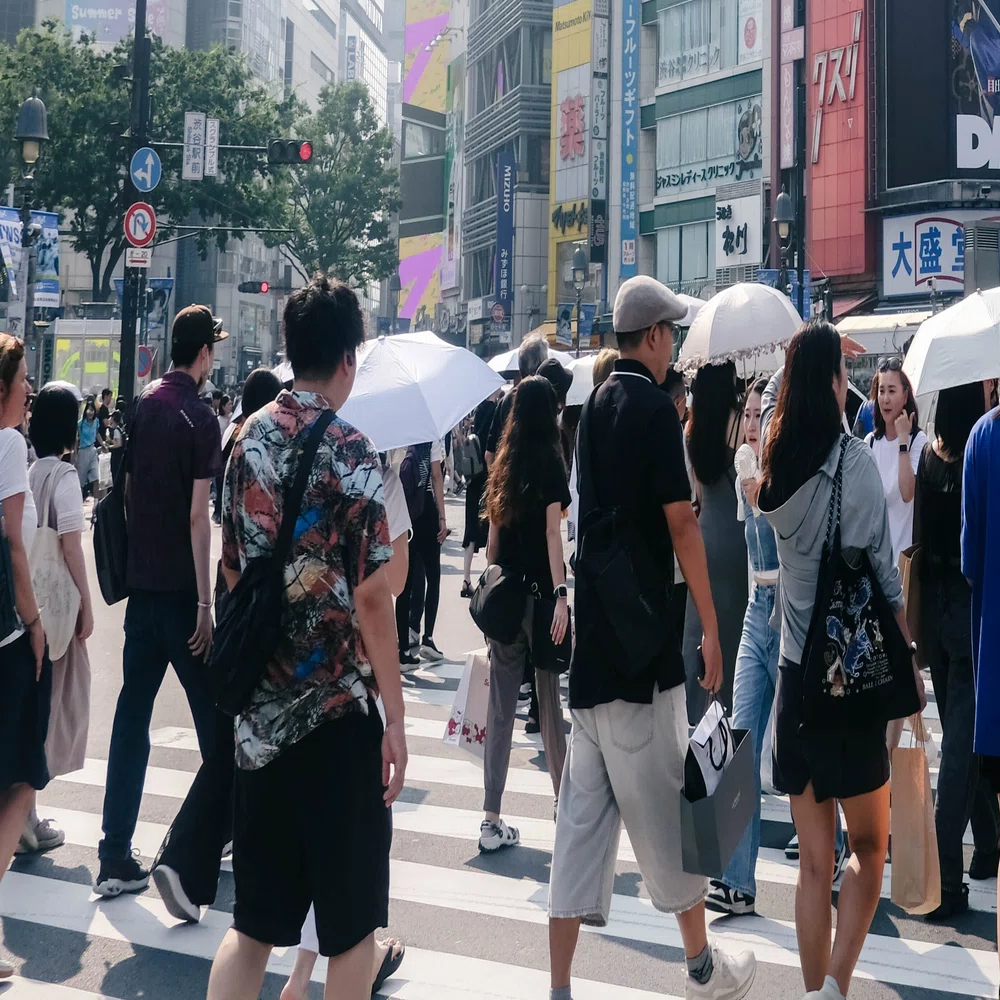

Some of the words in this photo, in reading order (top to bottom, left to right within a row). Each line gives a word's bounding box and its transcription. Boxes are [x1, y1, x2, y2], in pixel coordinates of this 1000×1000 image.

[71, 4, 122, 20] Summer
[127, 7, 154, 25] Se
[555, 13, 584, 33] Matsumoto
[560, 92, 586, 160] 薬
[192, 118, 202, 174] 渋谷駅前
[656, 161, 735, 190] ジャスミンレディースクリニック
[722, 222, 748, 257] 松川
[500, 248, 508, 300] みずほ銀行
